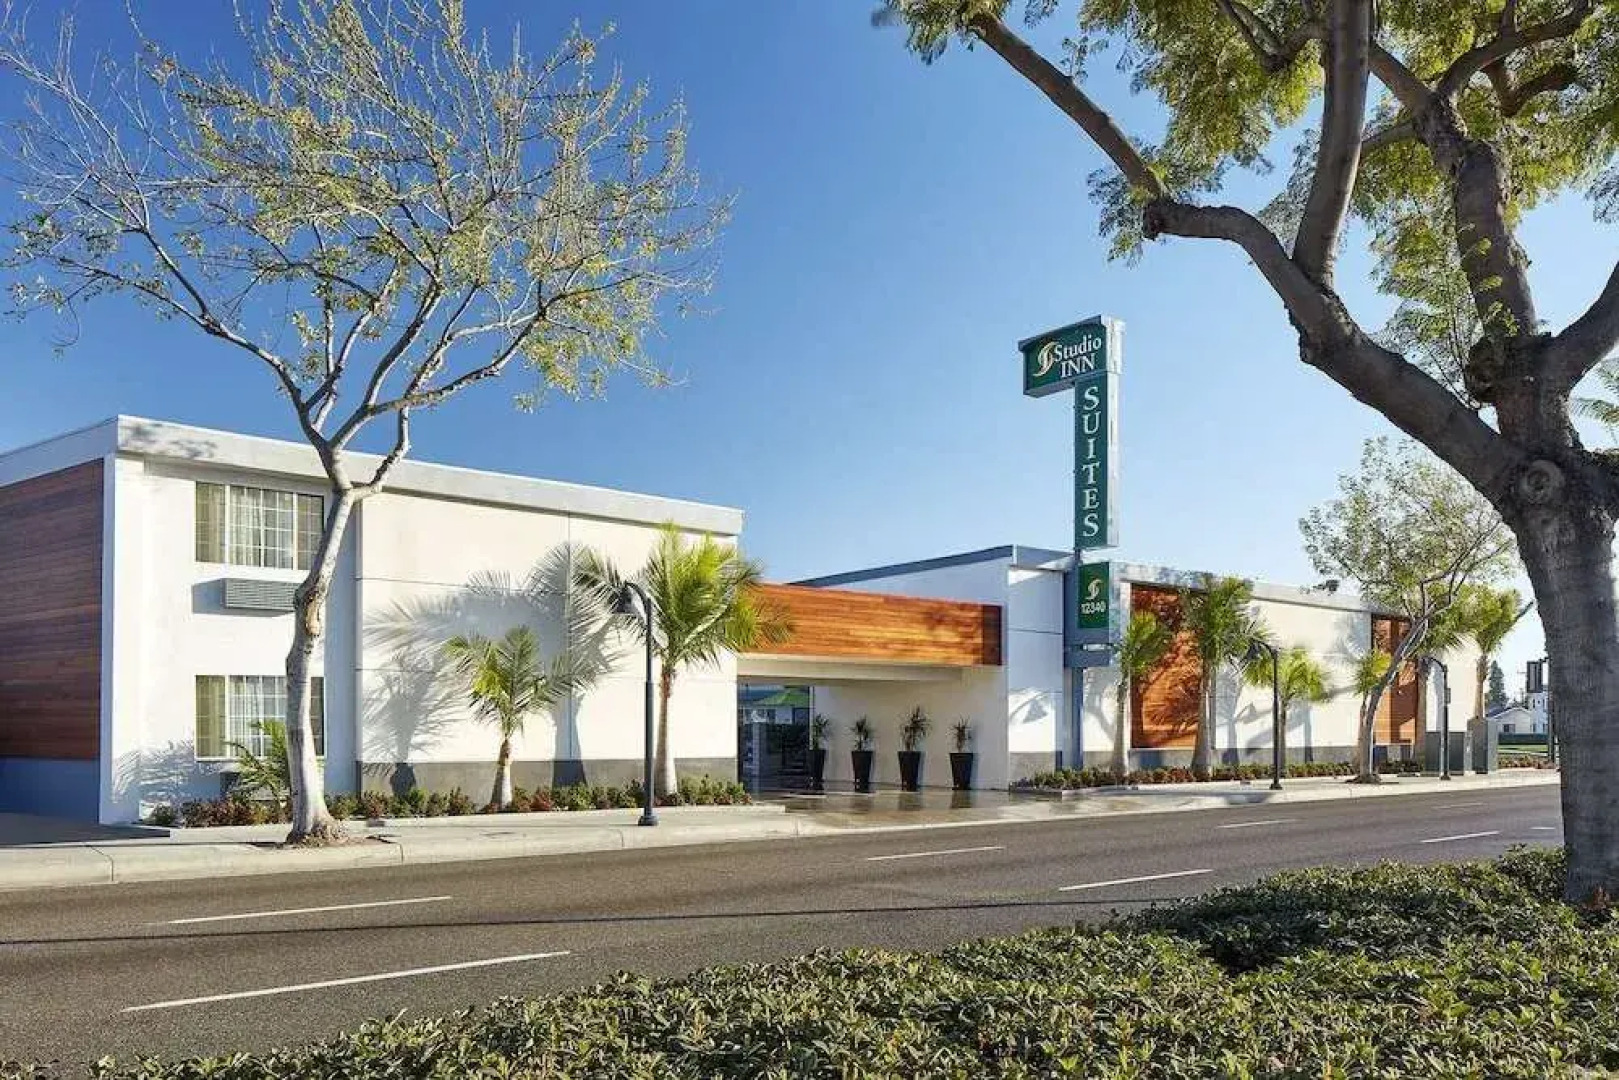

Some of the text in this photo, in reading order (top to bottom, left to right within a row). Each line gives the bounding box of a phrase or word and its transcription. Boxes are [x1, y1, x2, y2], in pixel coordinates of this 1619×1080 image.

[1054, 335, 1102, 360] Studio
[1060, 353, 1096, 378] INN
[1082, 386, 1101, 537] SUITES
